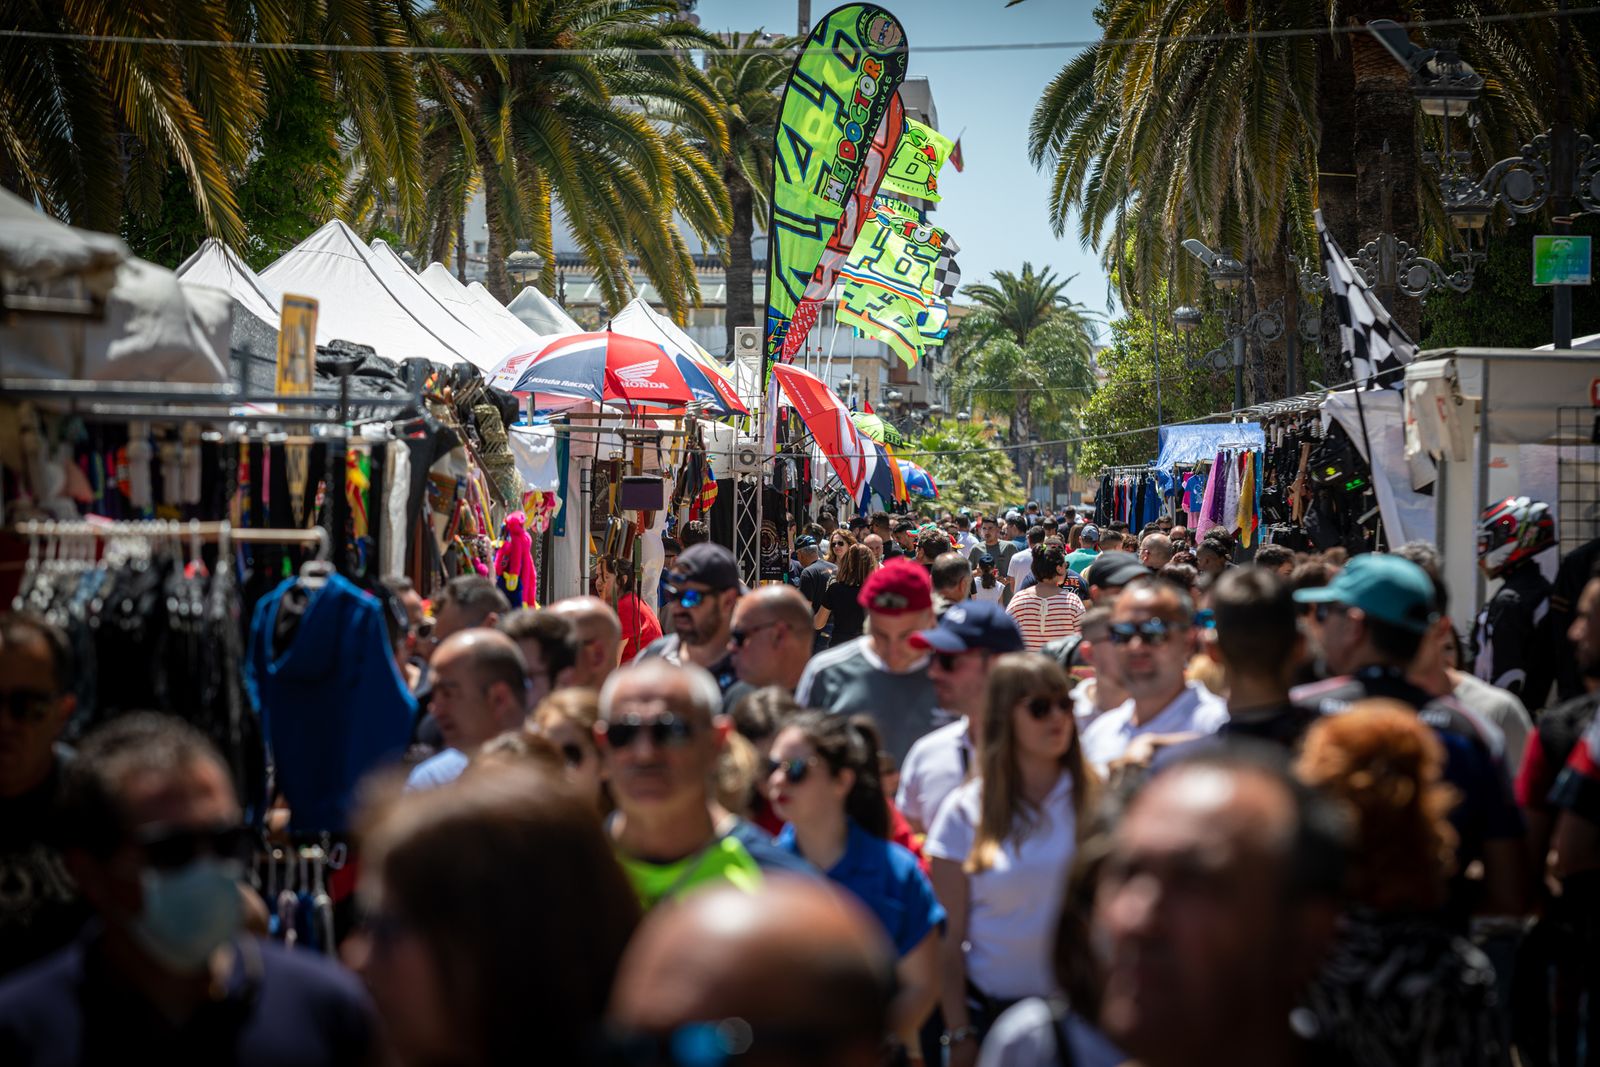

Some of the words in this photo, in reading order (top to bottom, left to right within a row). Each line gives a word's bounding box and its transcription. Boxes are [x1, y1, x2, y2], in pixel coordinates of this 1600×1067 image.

[821, 157, 855, 207] HE
[838, 55, 885, 163] DOCTOR
[528, 376, 561, 386] Honda
[561, 380, 594, 391] Racing
[620, 380, 670, 389] HONDA
[884, 433, 900, 446] 46
